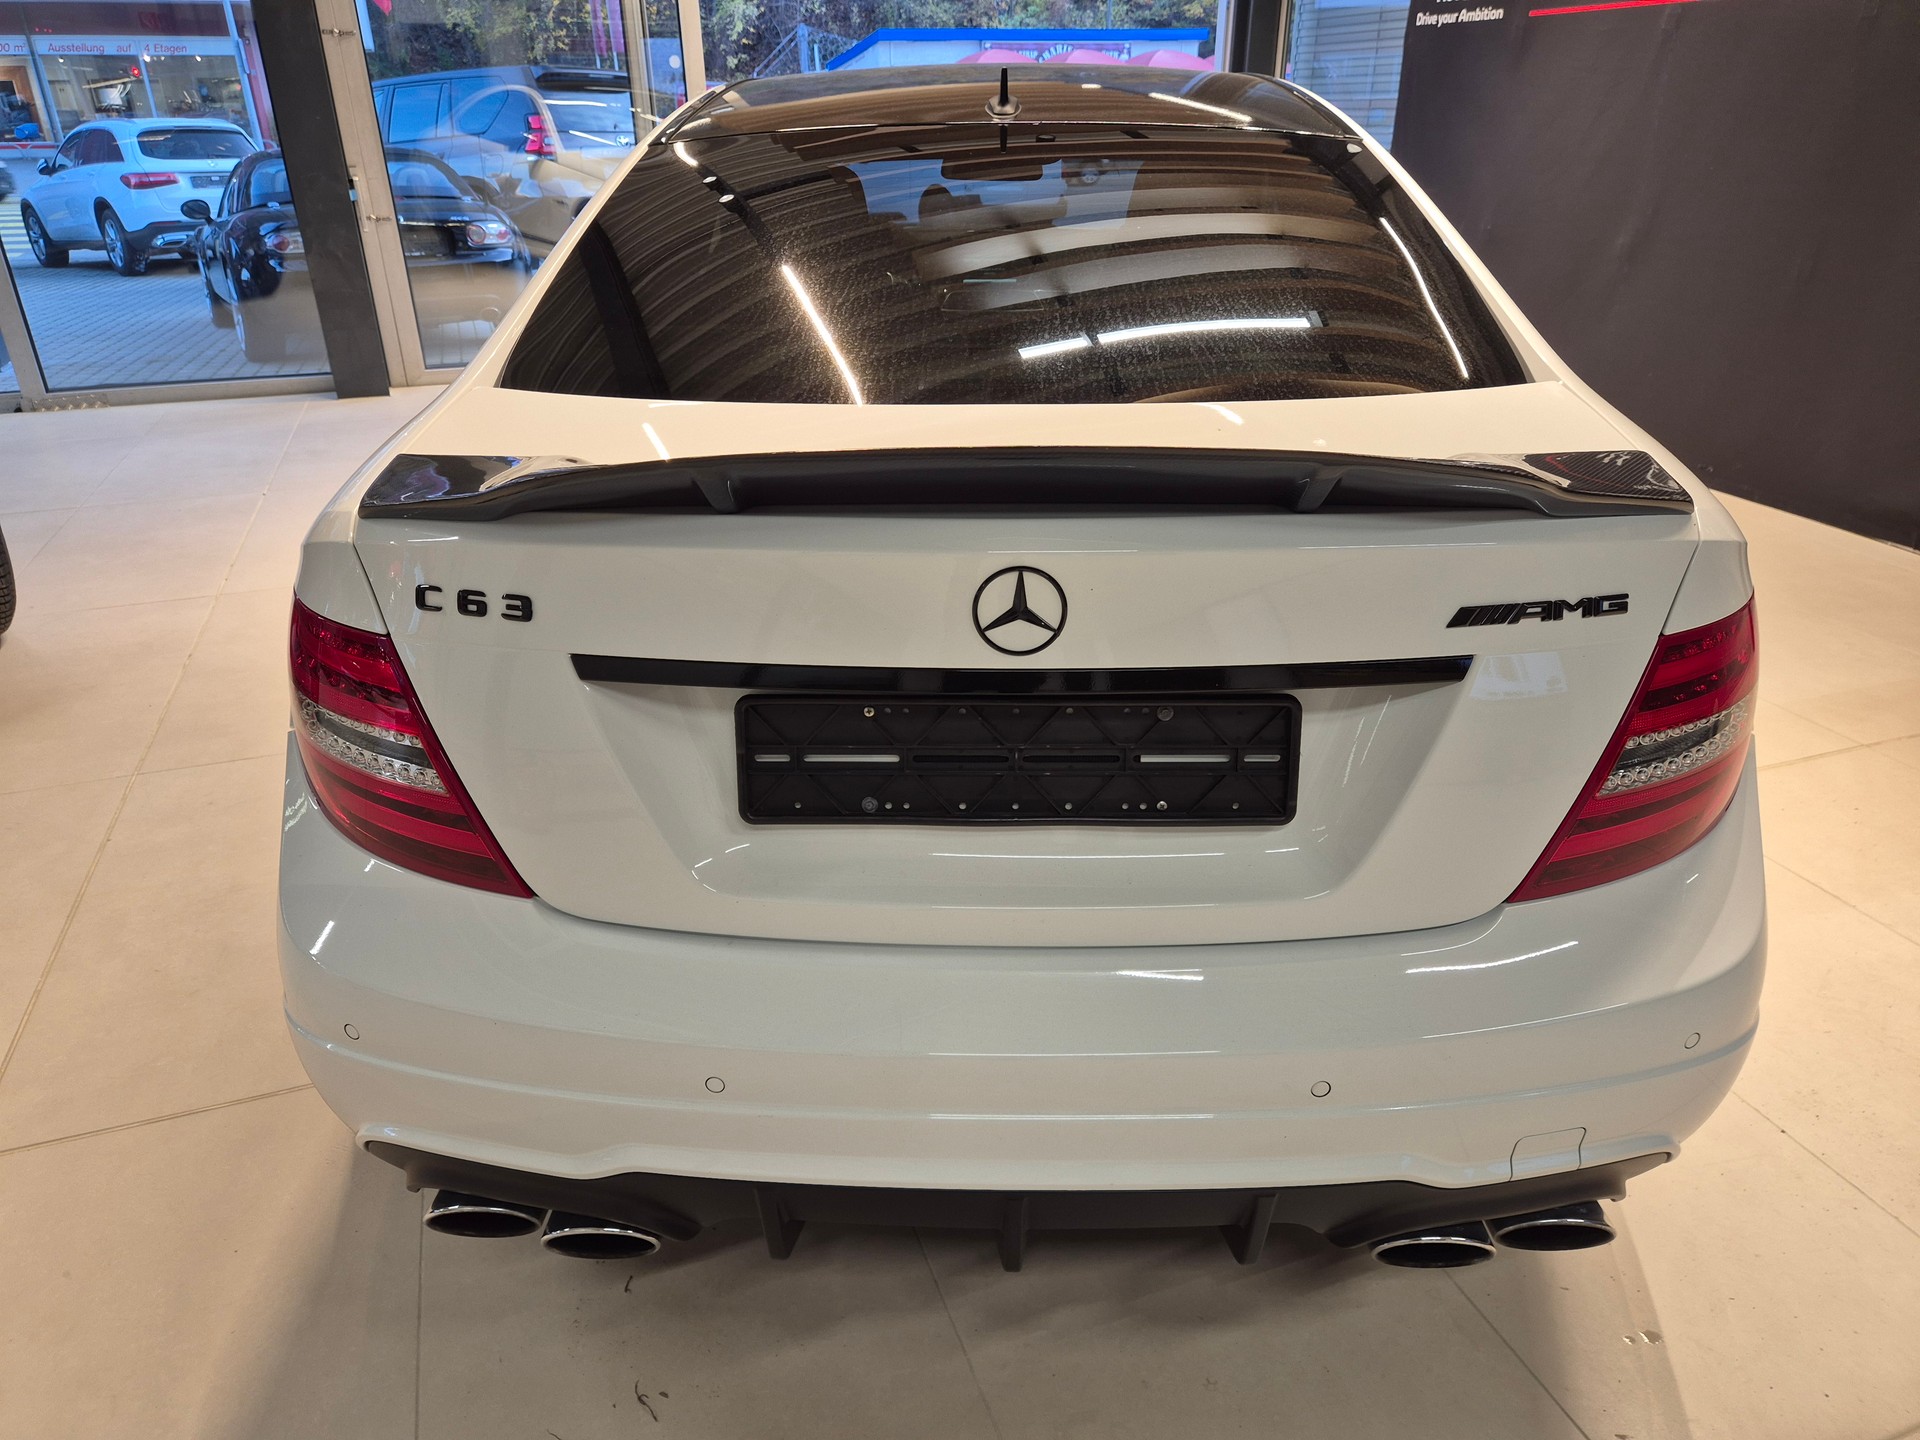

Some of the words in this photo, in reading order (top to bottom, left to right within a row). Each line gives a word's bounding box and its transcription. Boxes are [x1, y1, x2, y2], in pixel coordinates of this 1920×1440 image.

[1415, 12, 1438, 26] Drive
[1438, 12, 1459, 28] your
[1458, 6, 1505, 23] Ambition
[48, 43, 105, 54] Ausstellung
[116, 43, 131, 53] auf
[144, 43, 151, 52] 4
[154, 43, 187, 54] Etagen
[1507, 593, 1630, 625] AMG
